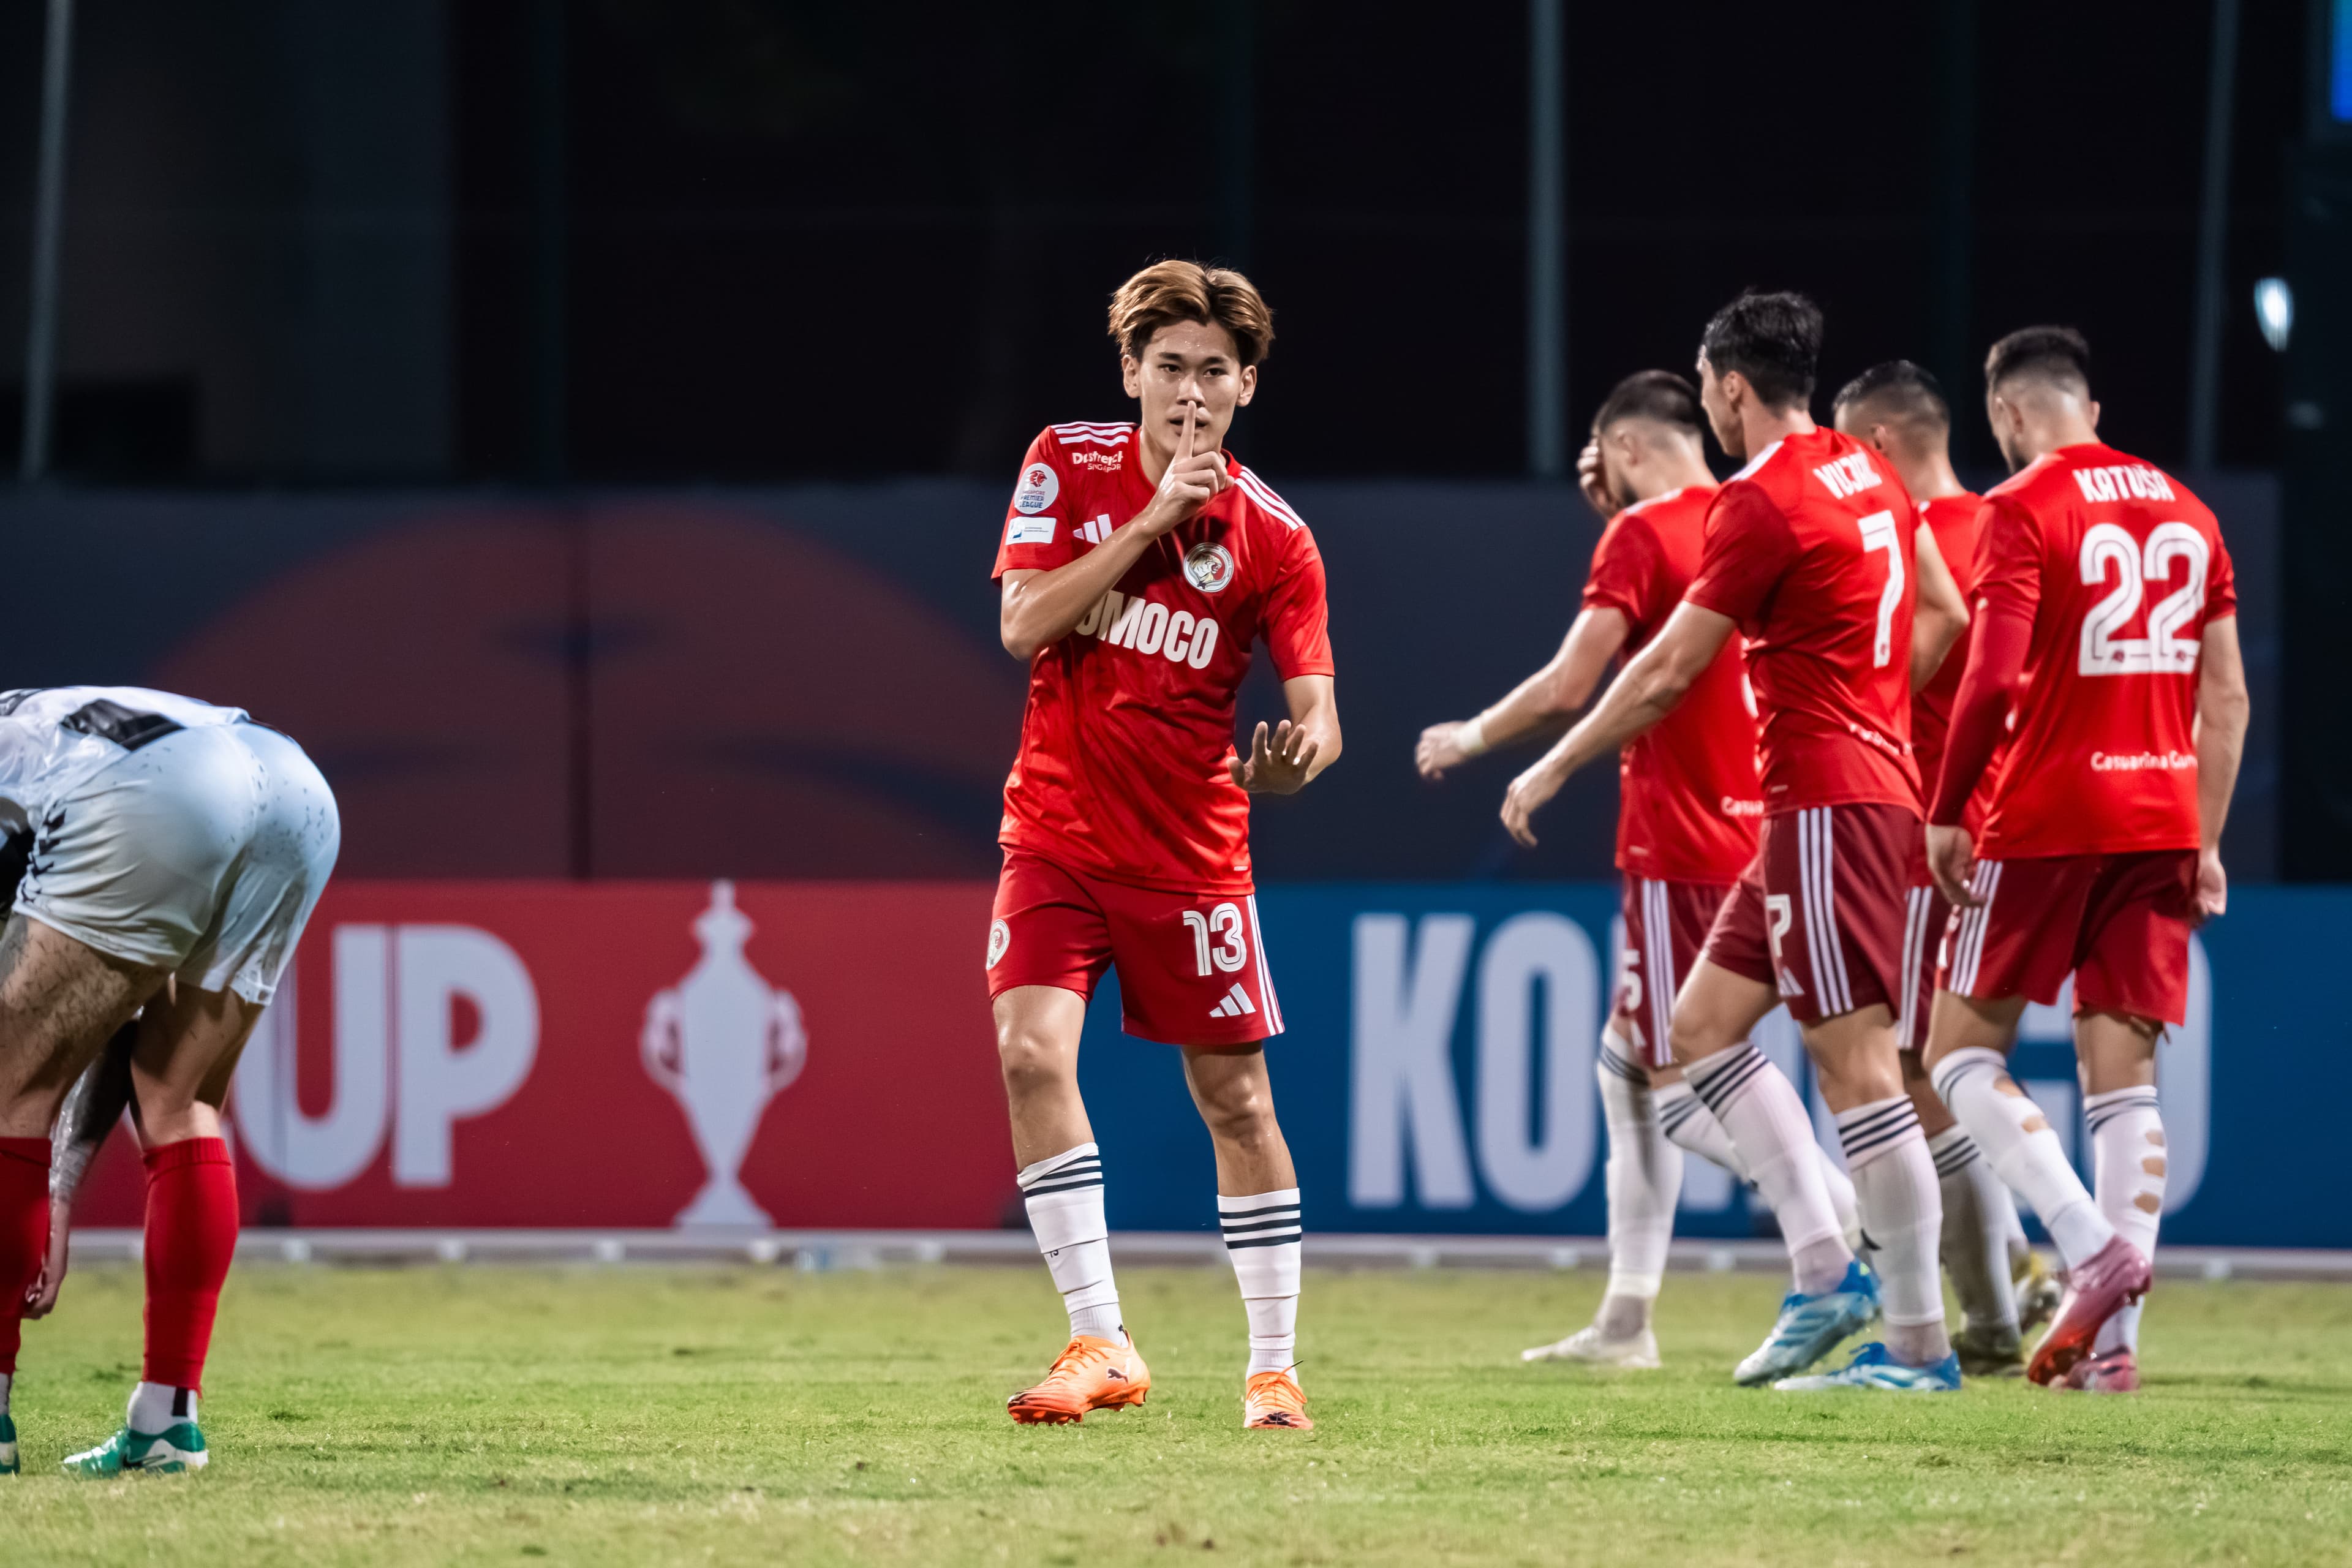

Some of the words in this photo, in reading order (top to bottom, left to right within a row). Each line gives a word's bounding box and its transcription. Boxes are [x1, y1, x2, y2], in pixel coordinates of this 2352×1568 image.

[1858, 510, 1905, 668] 7
[2077, 522, 2209, 677] 22
[1183, 902, 1247, 976] 13
[1765, 894, 1792, 957] 7
[233, 922, 541, 1191] UP
